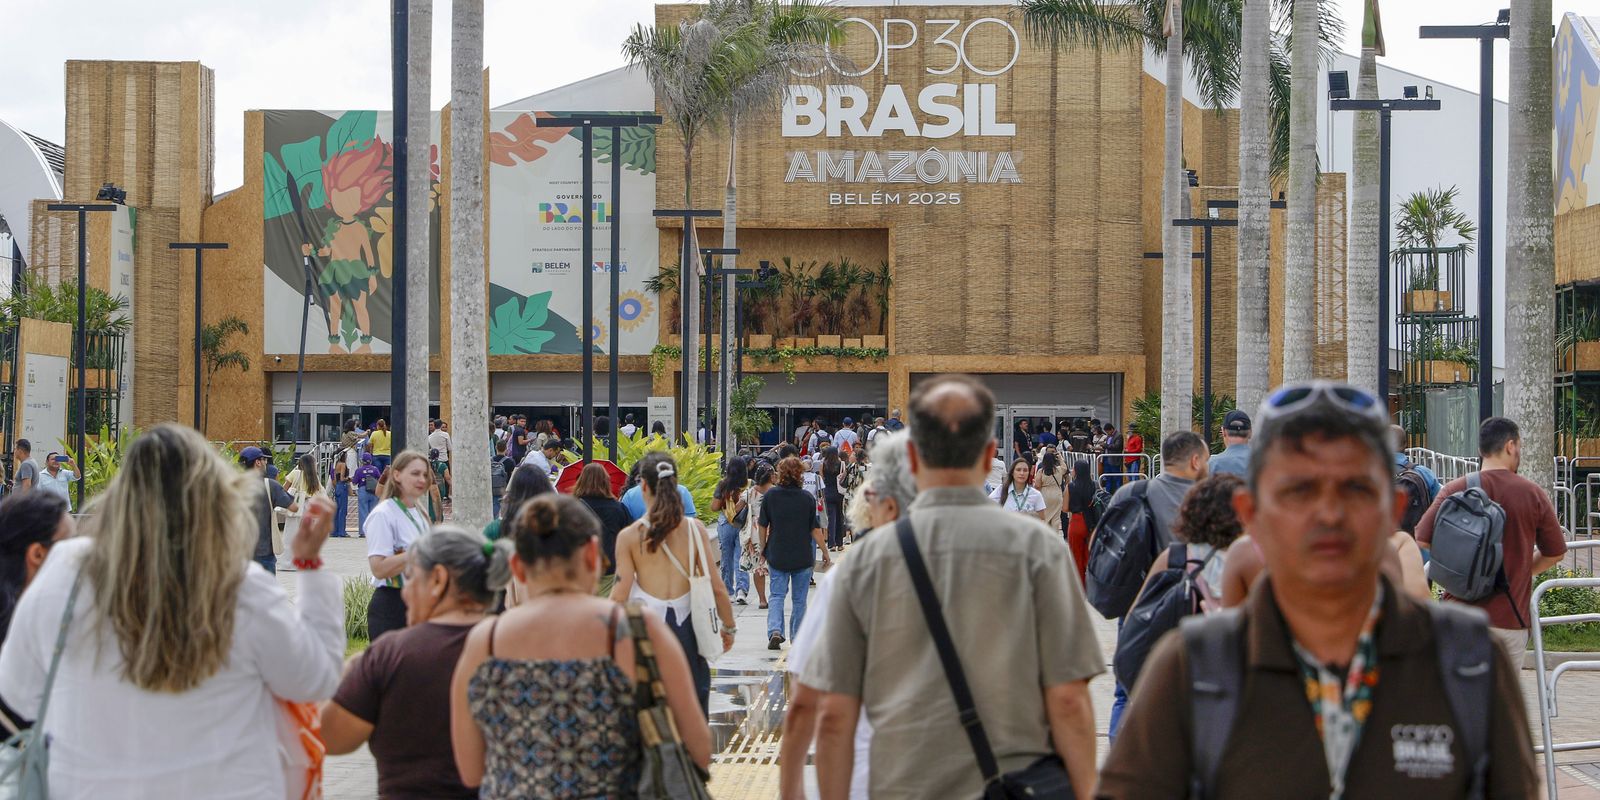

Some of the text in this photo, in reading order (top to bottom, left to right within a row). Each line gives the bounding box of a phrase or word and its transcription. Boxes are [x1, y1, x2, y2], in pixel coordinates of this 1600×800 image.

[781, 83, 1016, 138] BRASIL
[784, 147, 1021, 184] AMAZÔNIA
[829, 190, 961, 205] BELÉM 2025
[604, 264, 628, 273] PÁ
